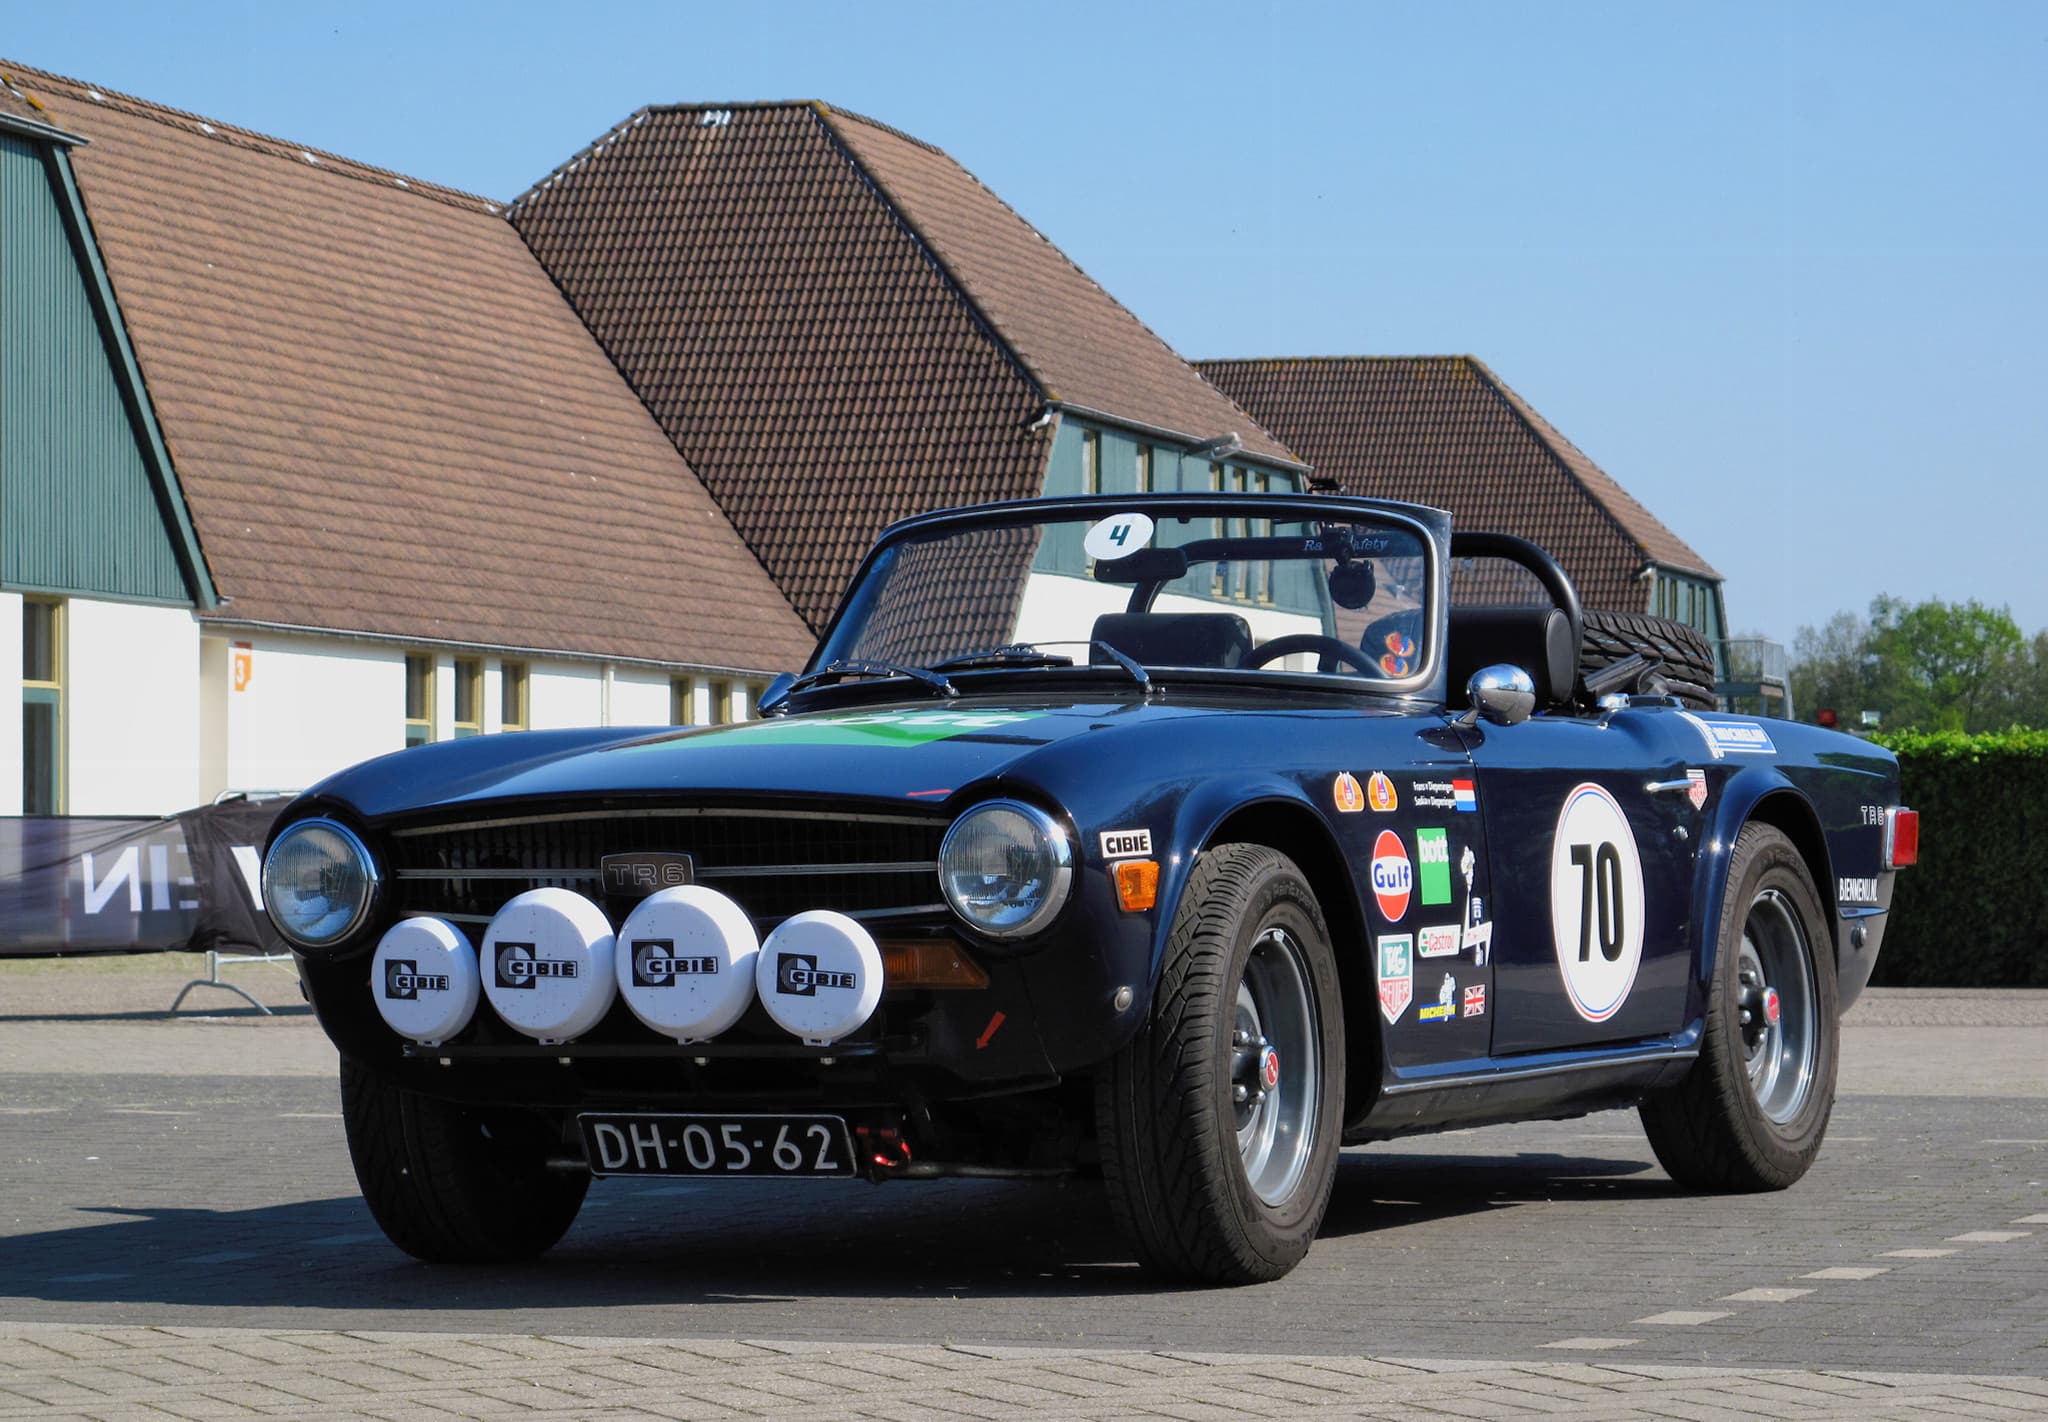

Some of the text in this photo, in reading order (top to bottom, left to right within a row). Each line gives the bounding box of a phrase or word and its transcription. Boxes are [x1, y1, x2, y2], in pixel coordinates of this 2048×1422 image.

[1109, 524, 1132, 546] 4
[1350, 538, 1389, 552] afety
[1860, 806, 1885, 825] TR6
[608, 863, 685, 886] TR6
[1374, 863, 1410, 888] Gulf
[1570, 841, 1625, 962] 70
[1428, 933, 1456, 952] Castrol
[593, 1123, 838, 1170] DH-05-62
